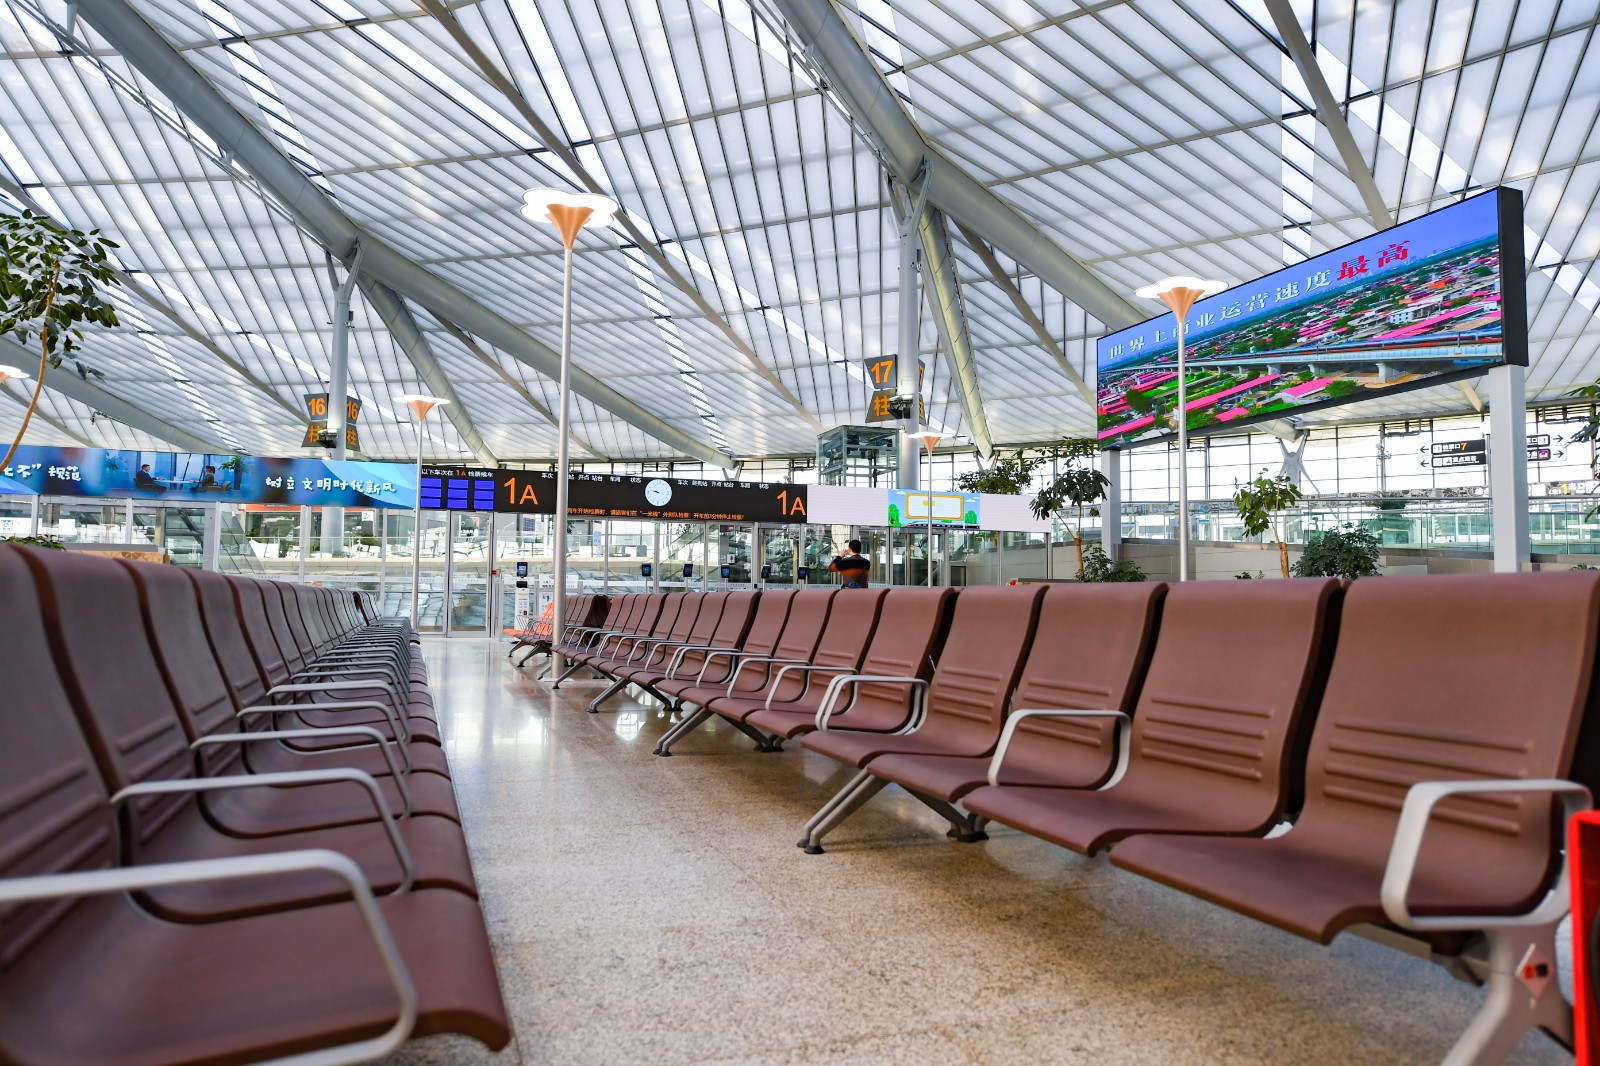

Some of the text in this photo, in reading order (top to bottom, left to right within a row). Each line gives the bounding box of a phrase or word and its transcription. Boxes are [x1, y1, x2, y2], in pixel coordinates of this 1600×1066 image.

[870, 360, 893, 384] 17
[308, 397, 327, 416] 16
[346, 400, 359, 420] 16
[873, 394, 891, 417] 柱
[1461, 442, 1467, 451] 7
[48, 465, 82, 482] 规范
[503, 477, 539, 505] 1A
[776, 490, 807, 516] 1A
